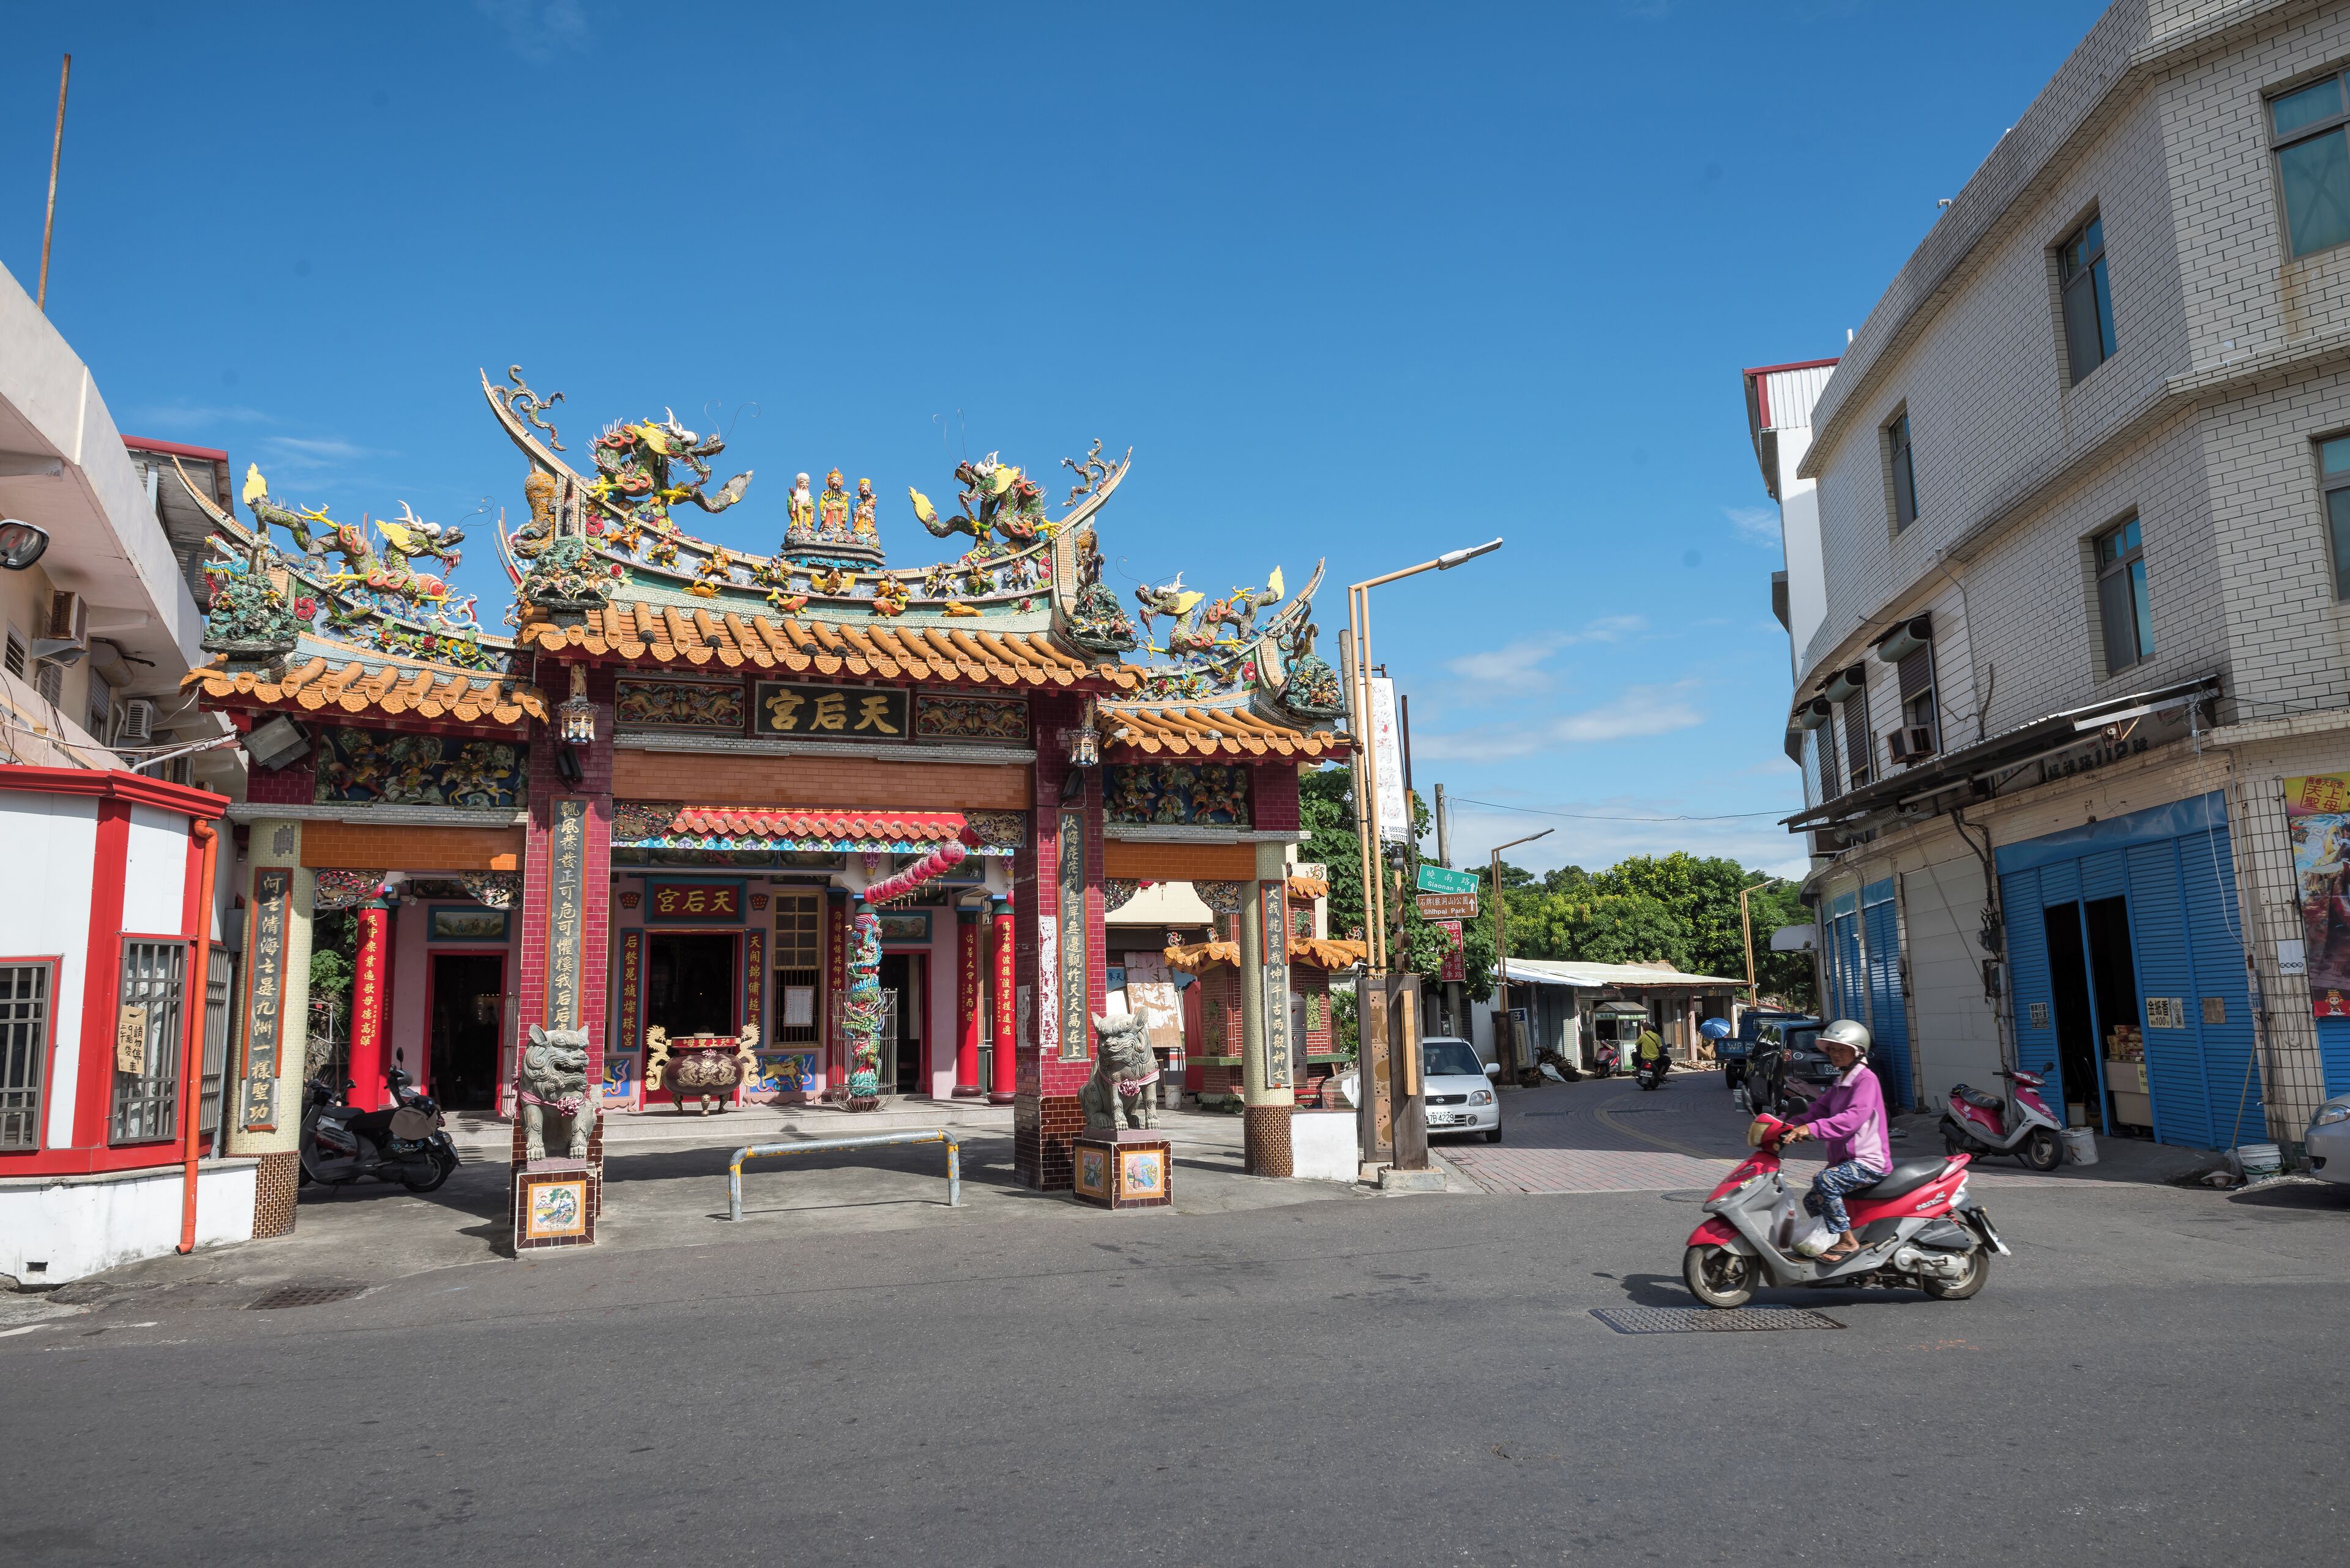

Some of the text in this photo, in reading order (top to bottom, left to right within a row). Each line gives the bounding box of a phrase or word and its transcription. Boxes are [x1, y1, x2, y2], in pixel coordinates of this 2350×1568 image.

[766, 689, 899, 734] 天后宮
[1427, 870, 1470, 886] 曉南路
[1428, 881, 1454, 891] Siaonan
[657, 888, 734, 912] 天后宮
[129, 1025, 143, 1073] 請勿停車
[687, 1039, 728, 1047] 天上聖母
[1429, 1114, 1454, 1122] 7B-4229
